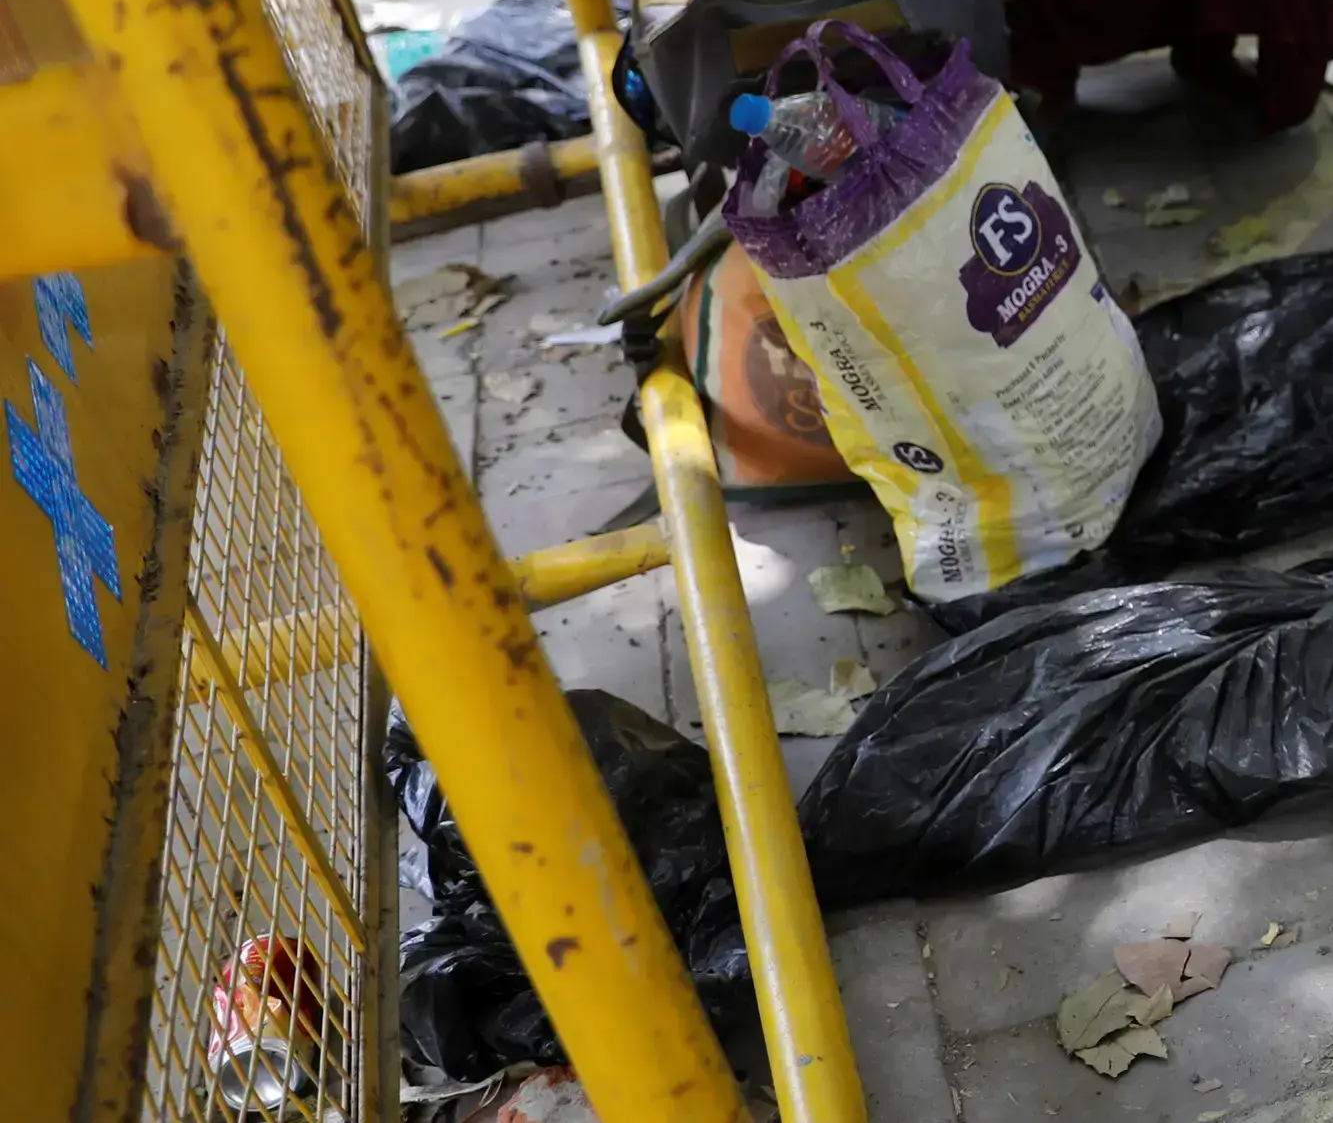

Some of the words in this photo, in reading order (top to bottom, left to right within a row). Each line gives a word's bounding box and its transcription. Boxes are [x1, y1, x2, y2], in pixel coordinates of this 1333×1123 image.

[979, 194, 1033, 267] FS
[996, 256, 1056, 323] MOGRA
[1054, 233, 1069, 253] 3
[809, 319, 828, 332] 3
[829, 347, 883, 411] MOGRA
